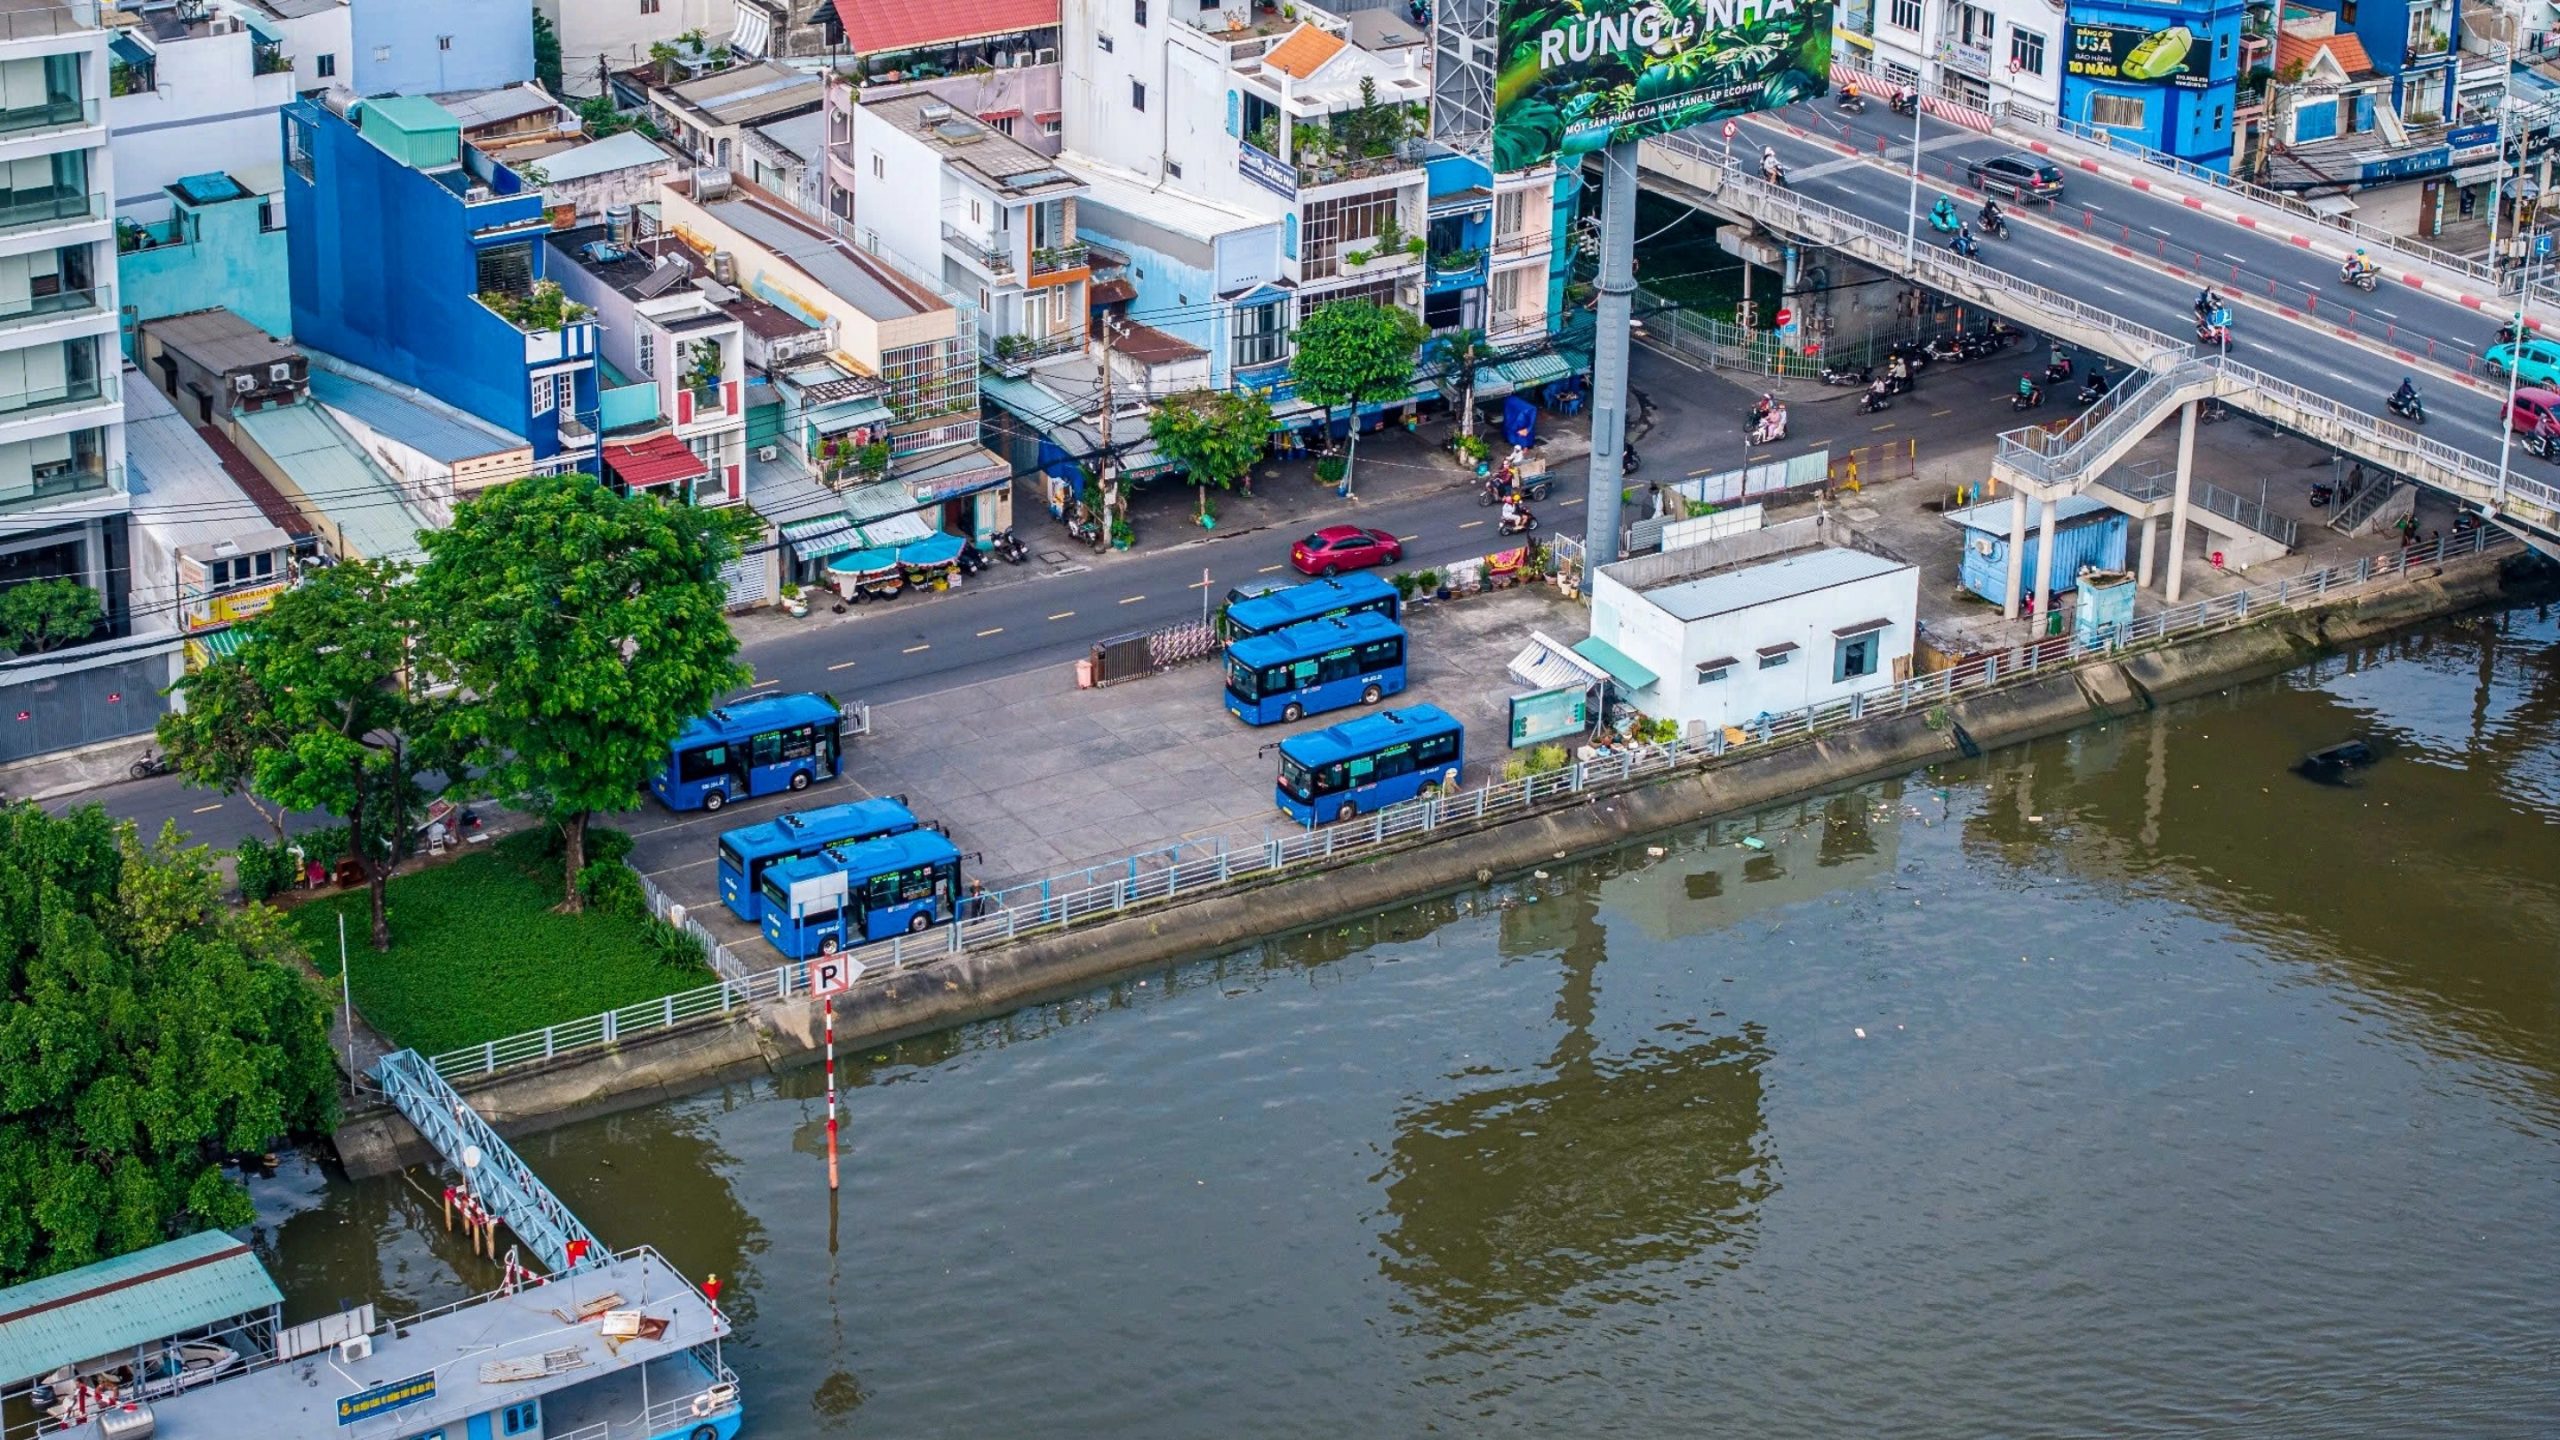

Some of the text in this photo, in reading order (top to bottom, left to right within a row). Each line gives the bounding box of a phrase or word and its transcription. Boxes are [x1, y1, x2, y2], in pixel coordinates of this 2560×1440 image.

[1541, 7, 1660, 69] RỪNG
[1671, 15, 1695, 40] Là
[2076, 35, 2112, 53] USA
[2069, 61, 2118, 77] 10 NĂM
[1565, 123, 1586, 135] MỘT
[1588, 116, 1607, 129] SẢN
[1637, 105, 1656, 118] CỦA
[1658, 99, 1677, 112] NHÀ
[1679, 95, 1703, 108] SÁNG
[1724, 81, 1764, 97] ECOPARK
[2507, 135, 2550, 155] PÚC
[821, 965, 837, 989] P
